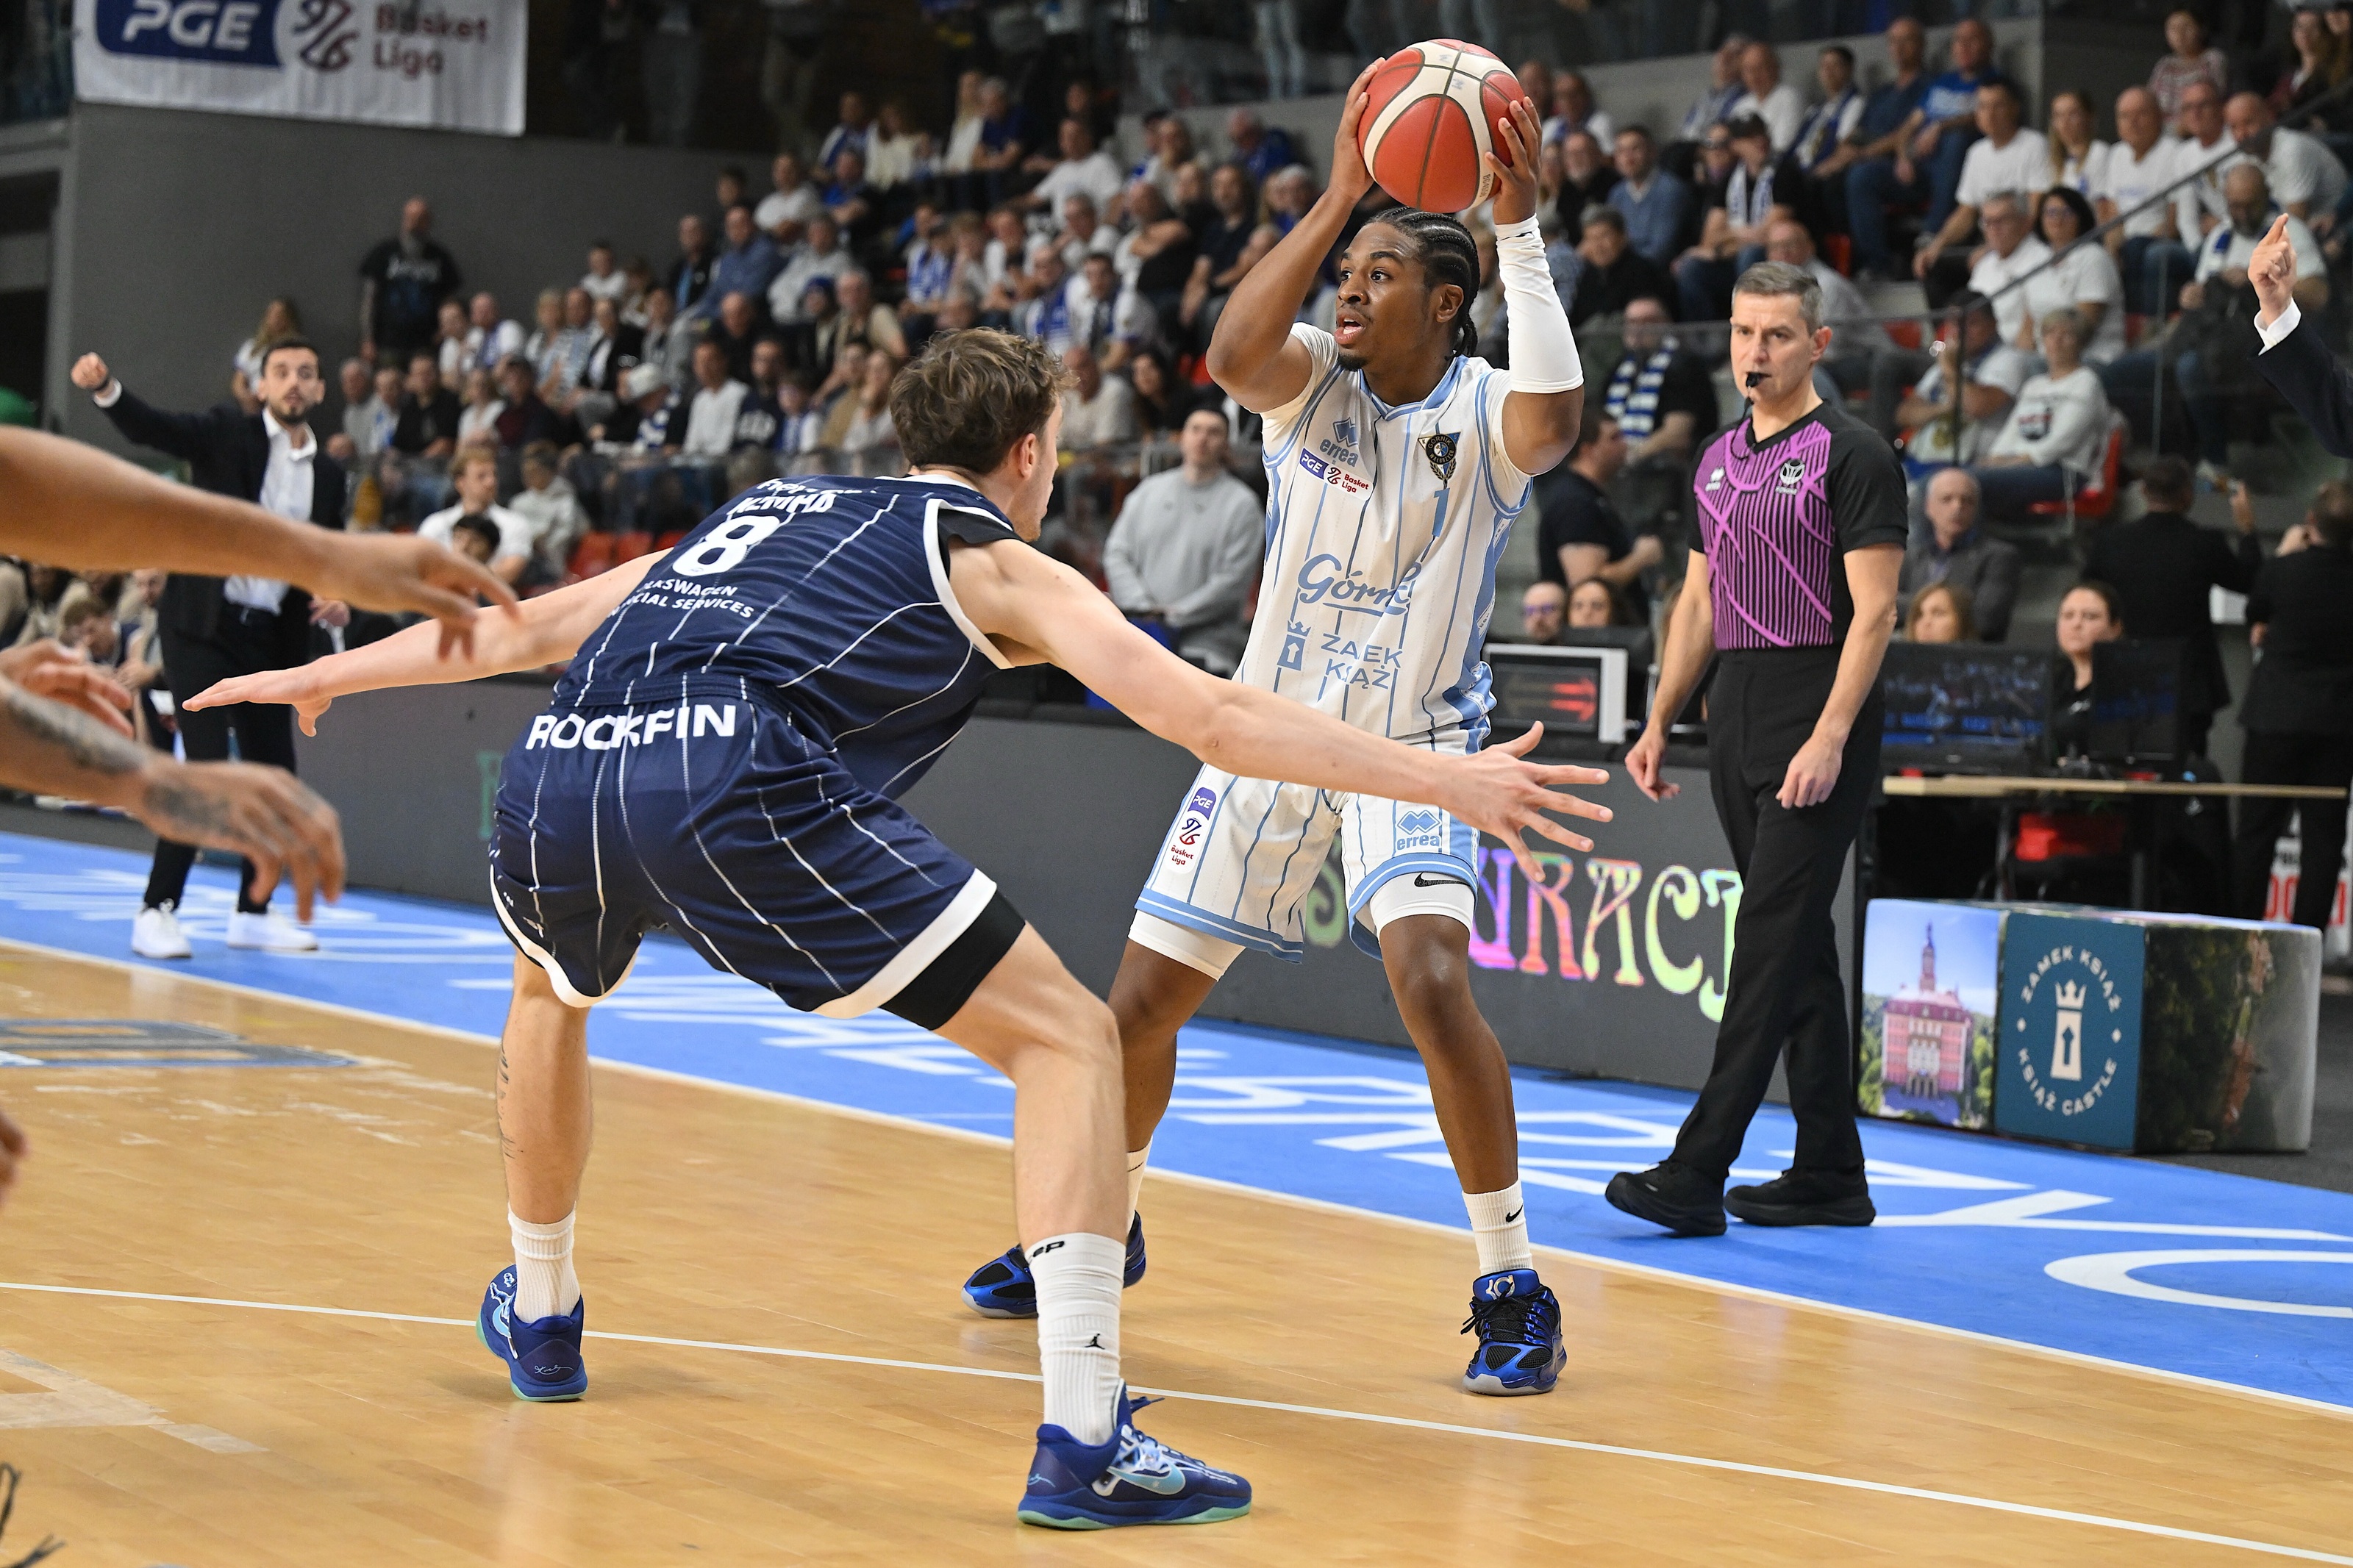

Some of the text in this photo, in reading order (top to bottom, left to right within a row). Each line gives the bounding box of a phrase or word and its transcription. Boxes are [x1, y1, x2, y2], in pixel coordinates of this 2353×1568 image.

[121, 0, 261, 51] PGE
[375, 4, 488, 43] Bsket
[374, 40, 445, 79] Liga
[1302, 454, 1323, 473] PGE
[1341, 482, 1357, 493] Liga
[1344, 474, 1369, 490] Basket
[1432, 487, 1450, 537] 1
[672, 515, 780, 576] 8
[672, 598, 754, 618] SERVICES
[1321, 633, 1403, 668] ZAEK
[525, 704, 736, 751] ROCKFIN
[1193, 795, 1213, 809] PGE
[1171, 845, 1194, 859] Basket
[1171, 855, 1186, 865] Liga
[1397, 834, 1440, 851] errea
[2020, 945, 2074, 1004] ZAMEK
[2061, 1057, 2118, 1117] CASTLE
